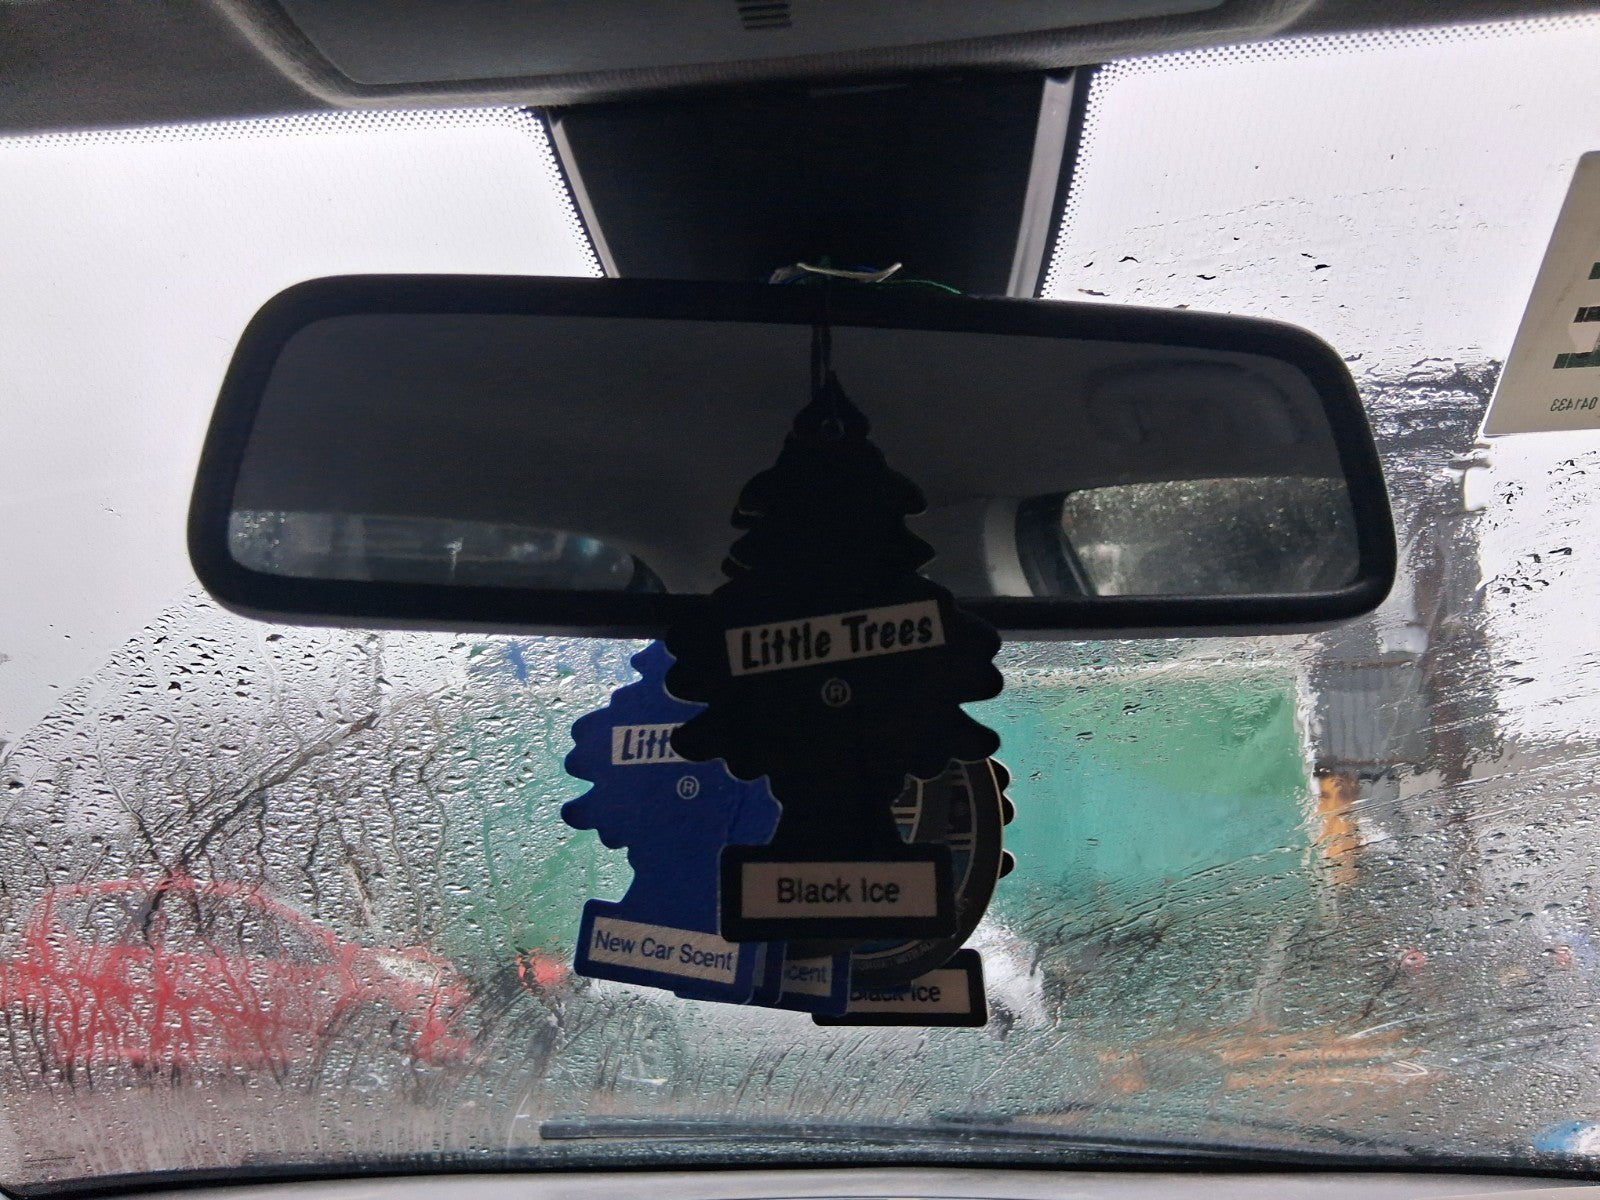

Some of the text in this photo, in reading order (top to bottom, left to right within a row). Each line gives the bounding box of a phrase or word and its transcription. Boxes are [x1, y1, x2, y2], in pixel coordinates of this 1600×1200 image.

[742, 614, 933, 670] Little Trees
[621, 728, 676, 761] Litt
[777, 876, 900, 904] Black Ice
[595, 930, 733, 971] New Car Scent
[786, 964, 828, 984] cent
